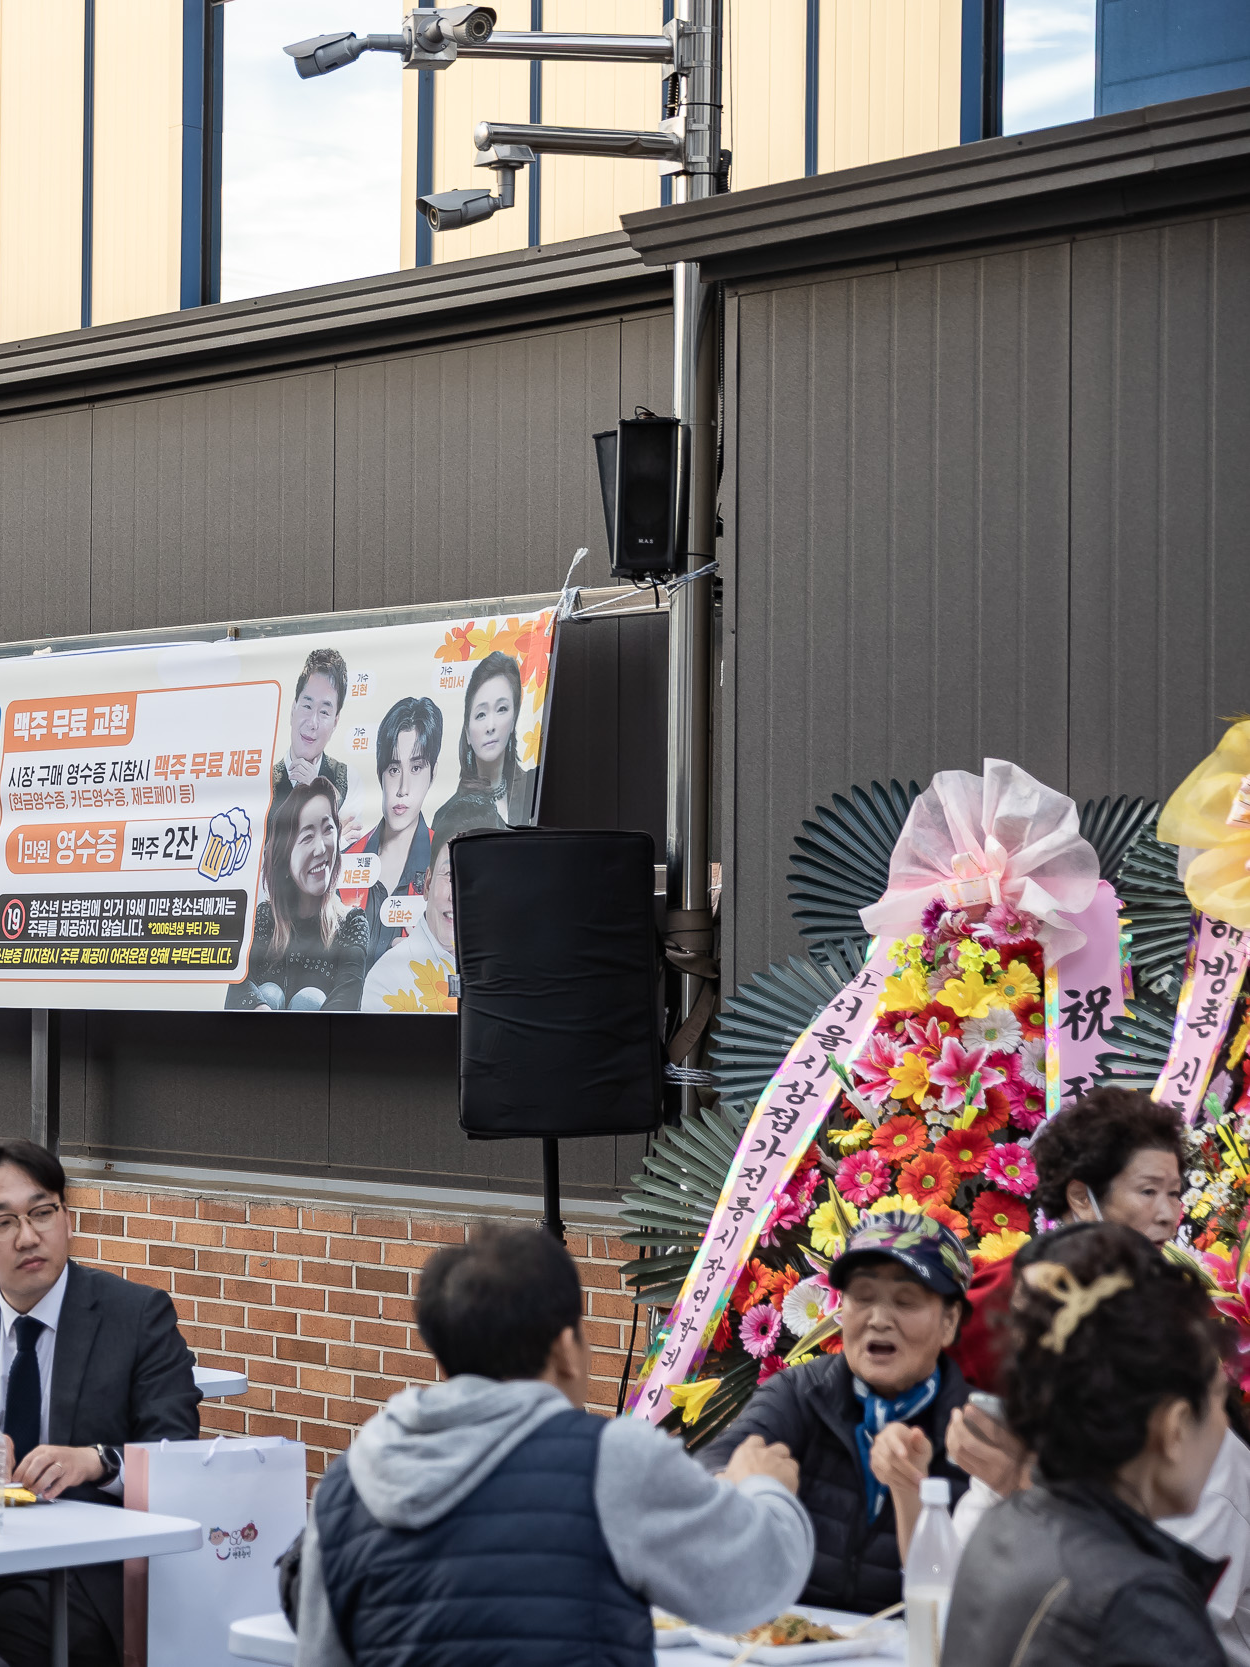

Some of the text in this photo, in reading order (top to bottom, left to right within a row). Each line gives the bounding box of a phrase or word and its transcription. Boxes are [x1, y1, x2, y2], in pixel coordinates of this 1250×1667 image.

[357, 673, 369, 682] 가수
[441, 666, 453, 675] 가수
[440, 676, 465, 689] 박미서
[351, 684, 368, 697] 김현
[13, 704, 130, 742] 맥주 무료 교환
[353, 727, 366, 737] 가수
[352, 737, 369, 750] 유민
[8, 749, 263, 788] 시장 구매 영수증 지참시 맥주 무료 제공
[8, 783, 195, 812] (현금영수증, 카드영수증, 제로페이 등)
[18, 825, 198, 865] 1만원 영수증 맥주 2잔
[343, 869, 371, 884] 채은옥
[30, 897, 237, 918] 청소년 보호법에 의거 19세 미만 청소년에게는
[390, 899, 402, 909] 가수
[7, 908, 21, 930] 19
[388, 910, 412, 923] 김완수
[27, 919, 58, 937] 주류를
[59, 919, 99, 937] 제공하지
[101, 918, 145, 937] 않습니다.
[186, 922, 202, 936] 부터
[204, 921, 220, 936] 가능
[23, 948, 59, 964] 미지참시
[60, 948, 80, 964] 주류
[81, 947, 108, 964] 제공이
[110, 947, 148, 964] 어려운점
[150, 947, 169, 964] 양해
[171, 947, 233, 964] 부탁드립니다.
